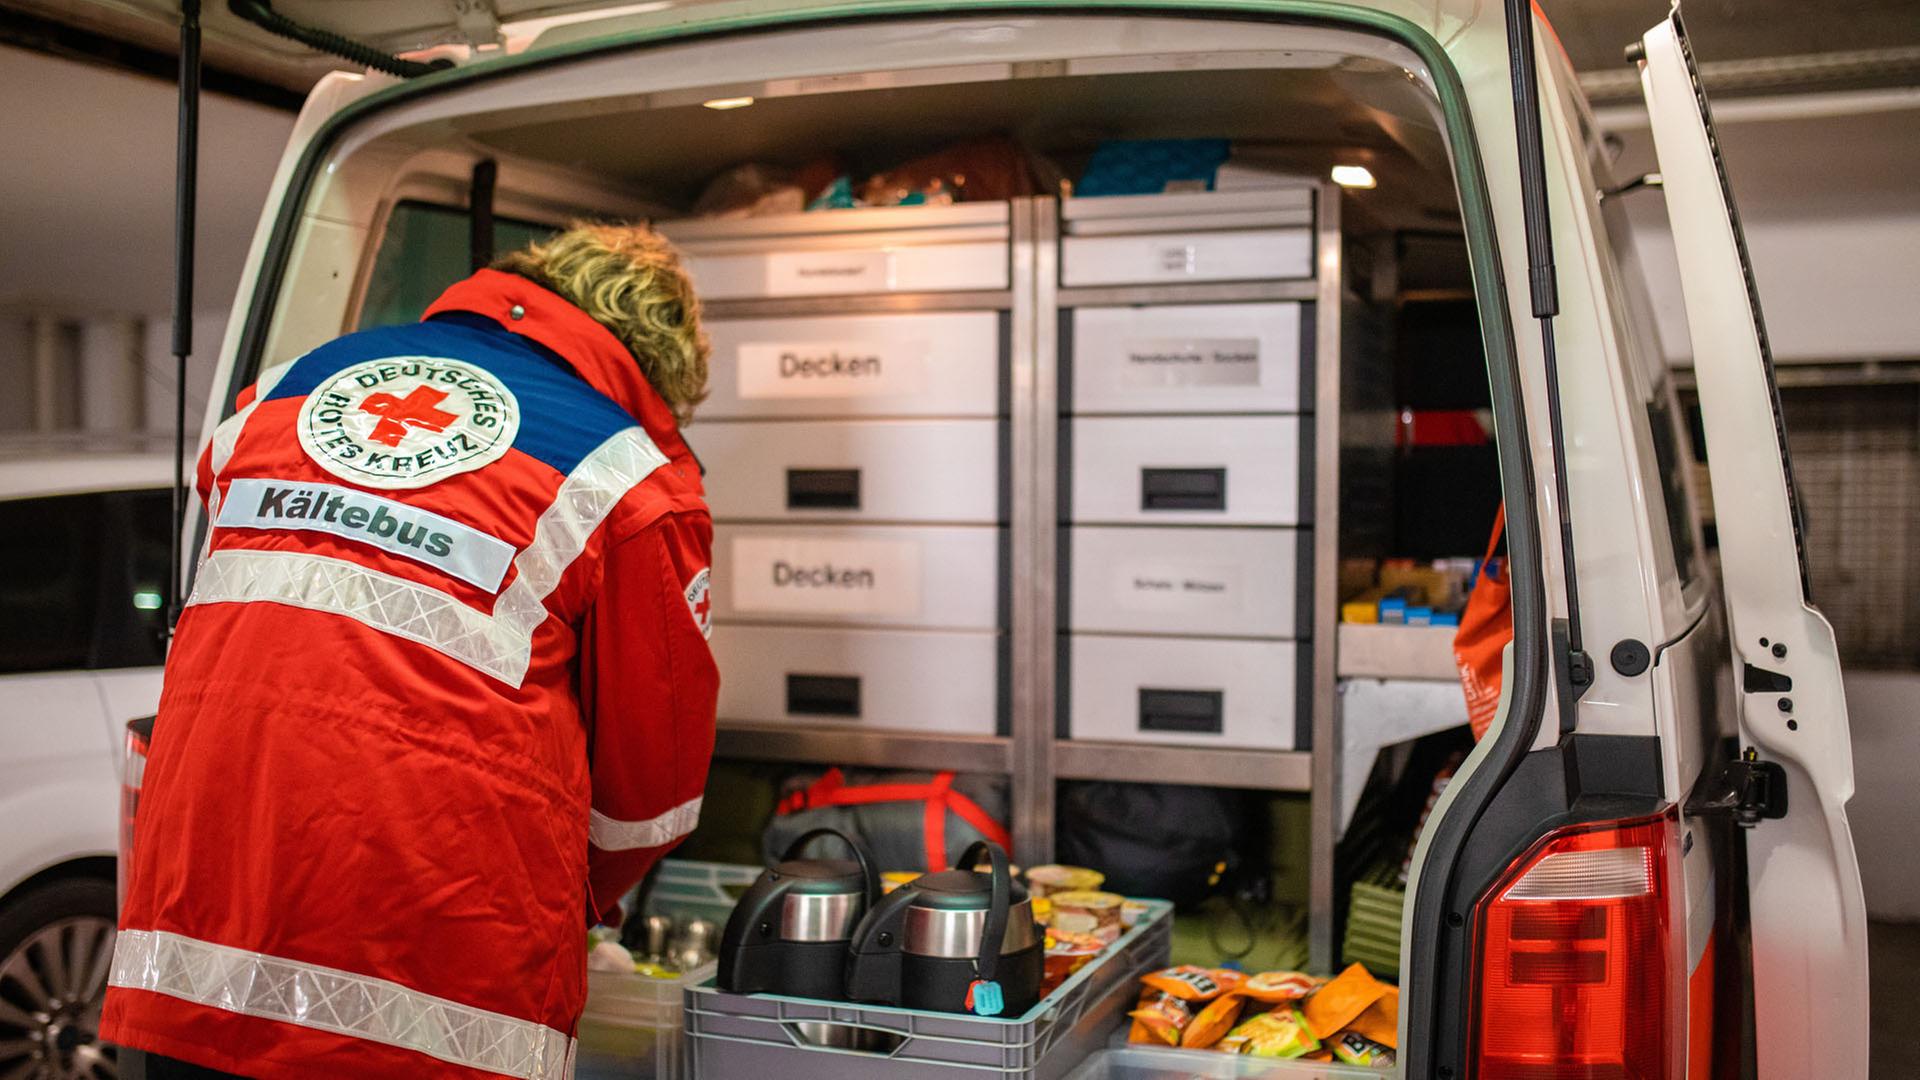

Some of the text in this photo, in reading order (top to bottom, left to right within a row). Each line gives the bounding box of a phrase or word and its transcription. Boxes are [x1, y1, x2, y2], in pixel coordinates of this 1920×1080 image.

[354, 363, 498, 429] DEUTSCHES
[779, 350, 881, 378] Decken
[318, 392, 478, 472] ROTES KREUZ
[256, 487, 454, 558] Kältebus
[772, 560, 874, 589] Decken
